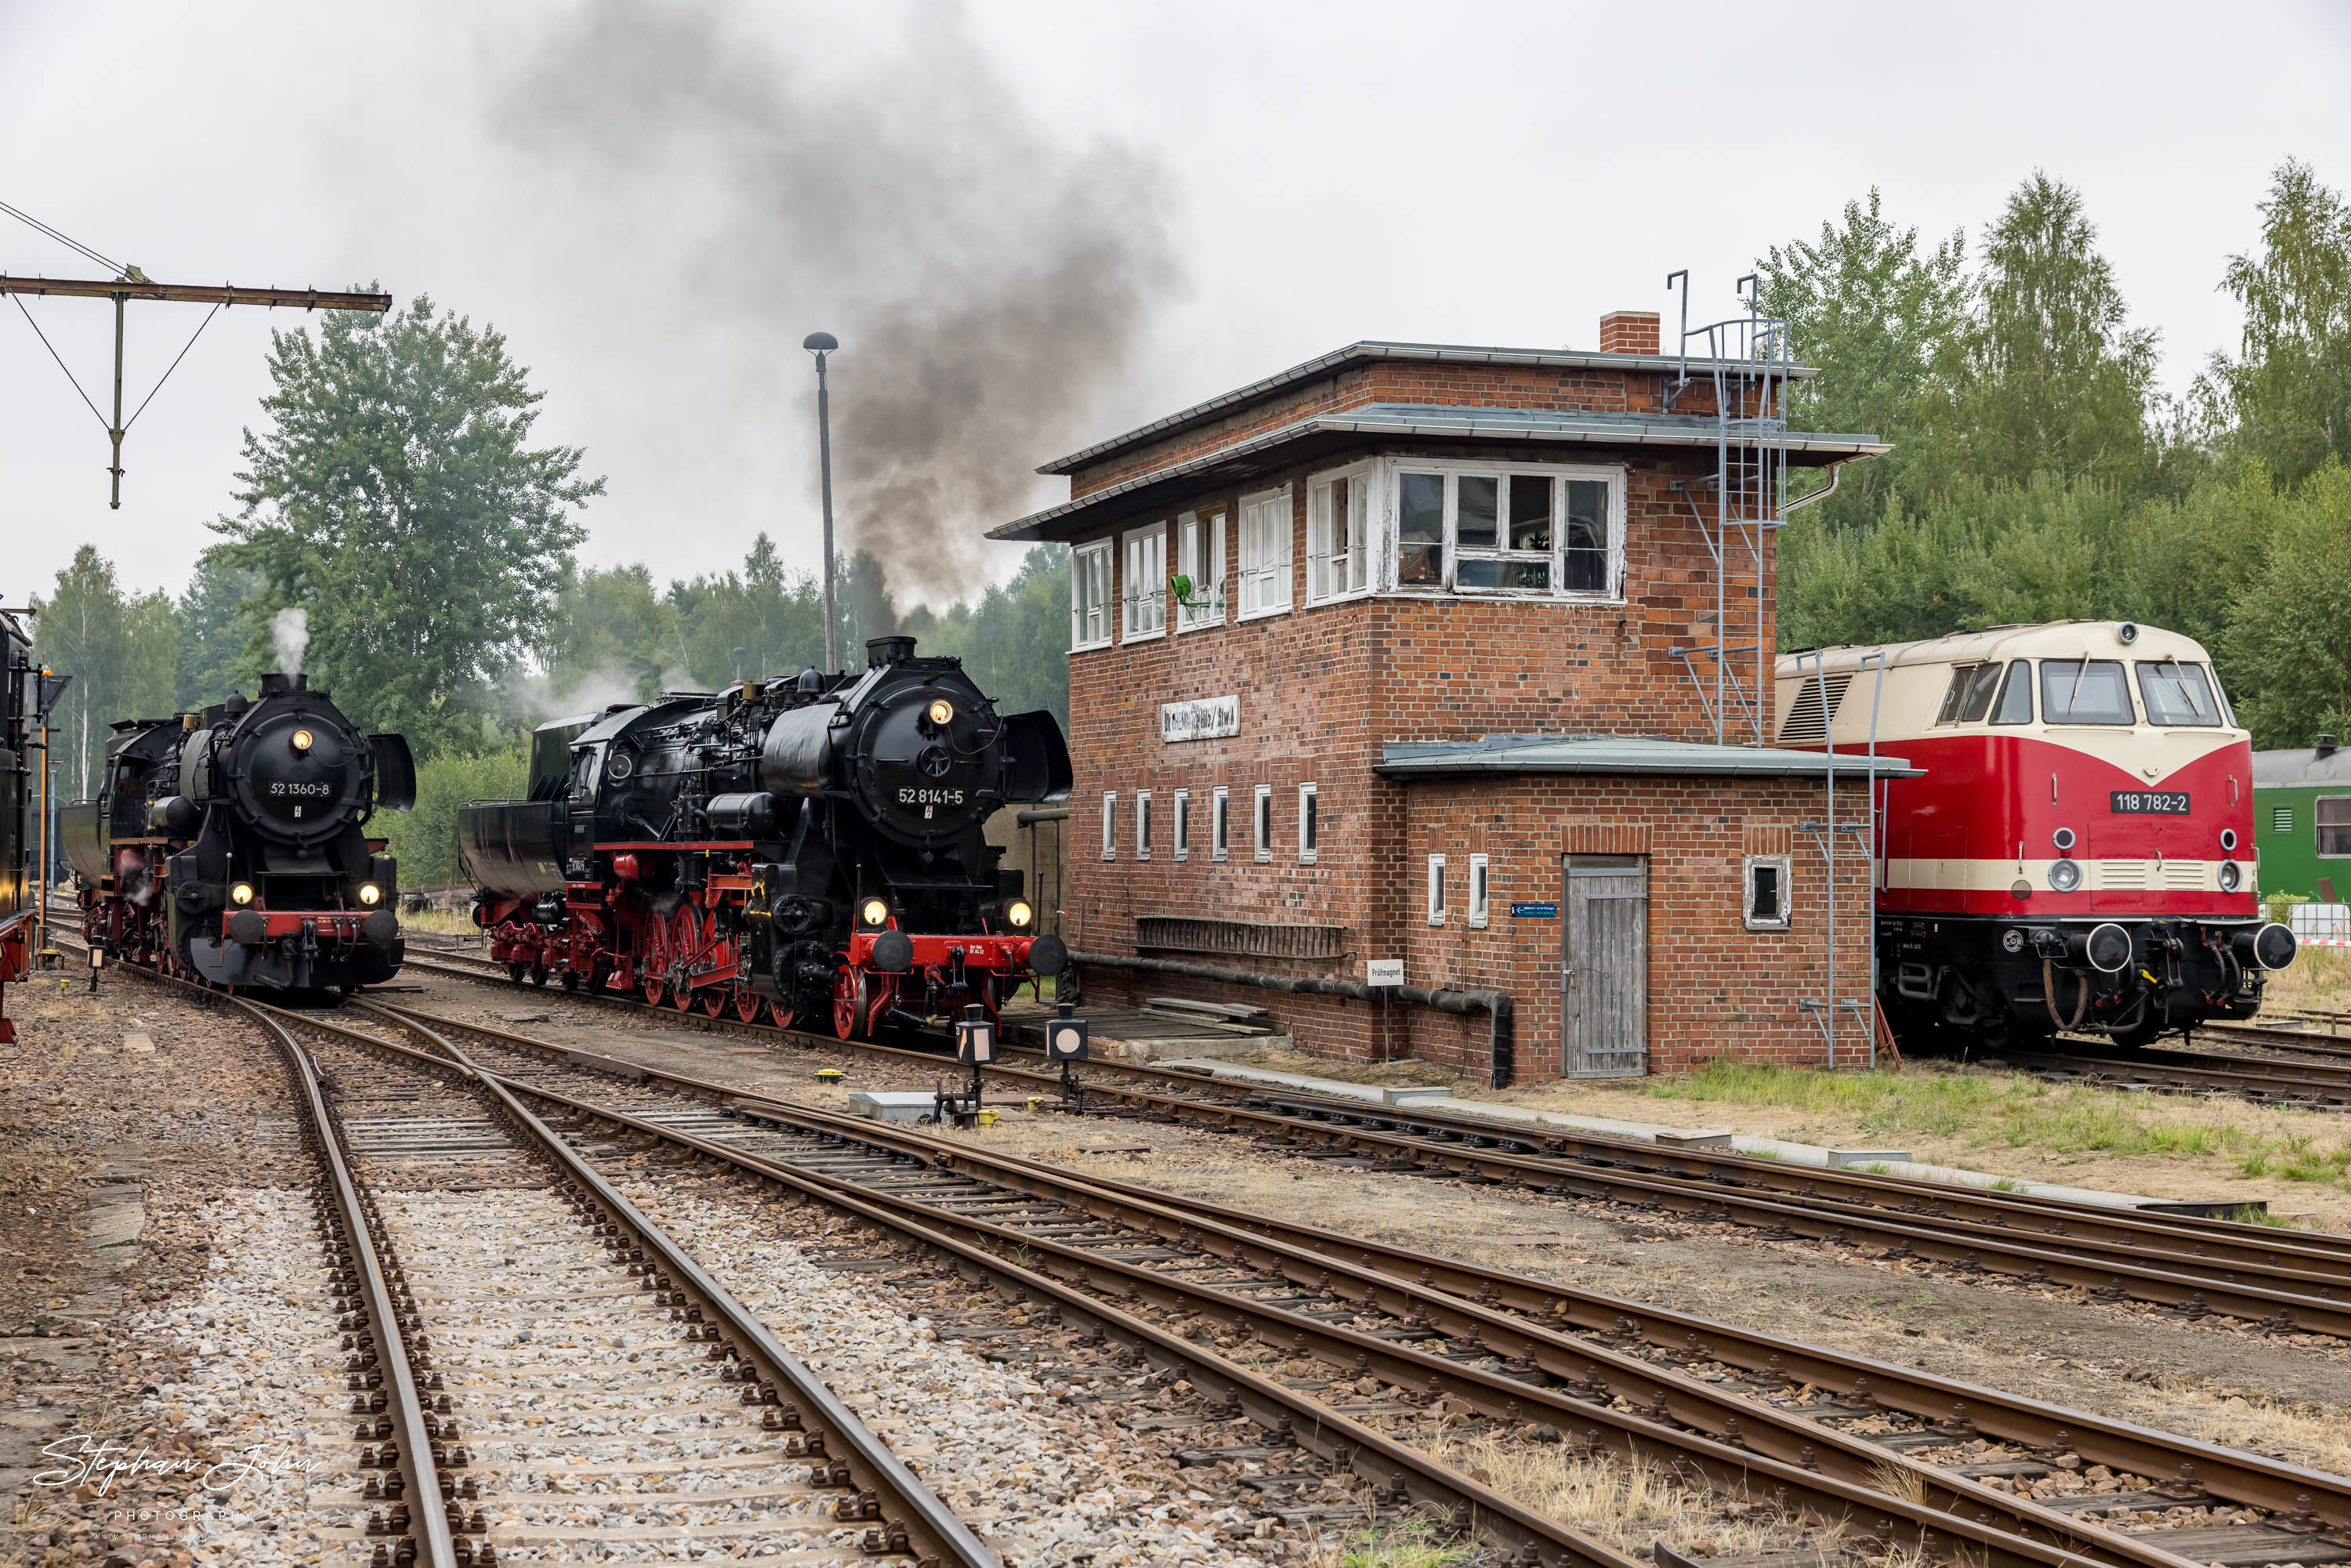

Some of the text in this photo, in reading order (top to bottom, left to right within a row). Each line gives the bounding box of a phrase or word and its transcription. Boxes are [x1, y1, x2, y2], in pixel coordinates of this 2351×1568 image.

[270, 784, 329, 795] 52 1360-8
[899, 788, 964, 804] 52 8141-5
[2117, 794, 2186, 811] 118 782-2
[1372, 968, 1400, 978] Prüfmagnet
